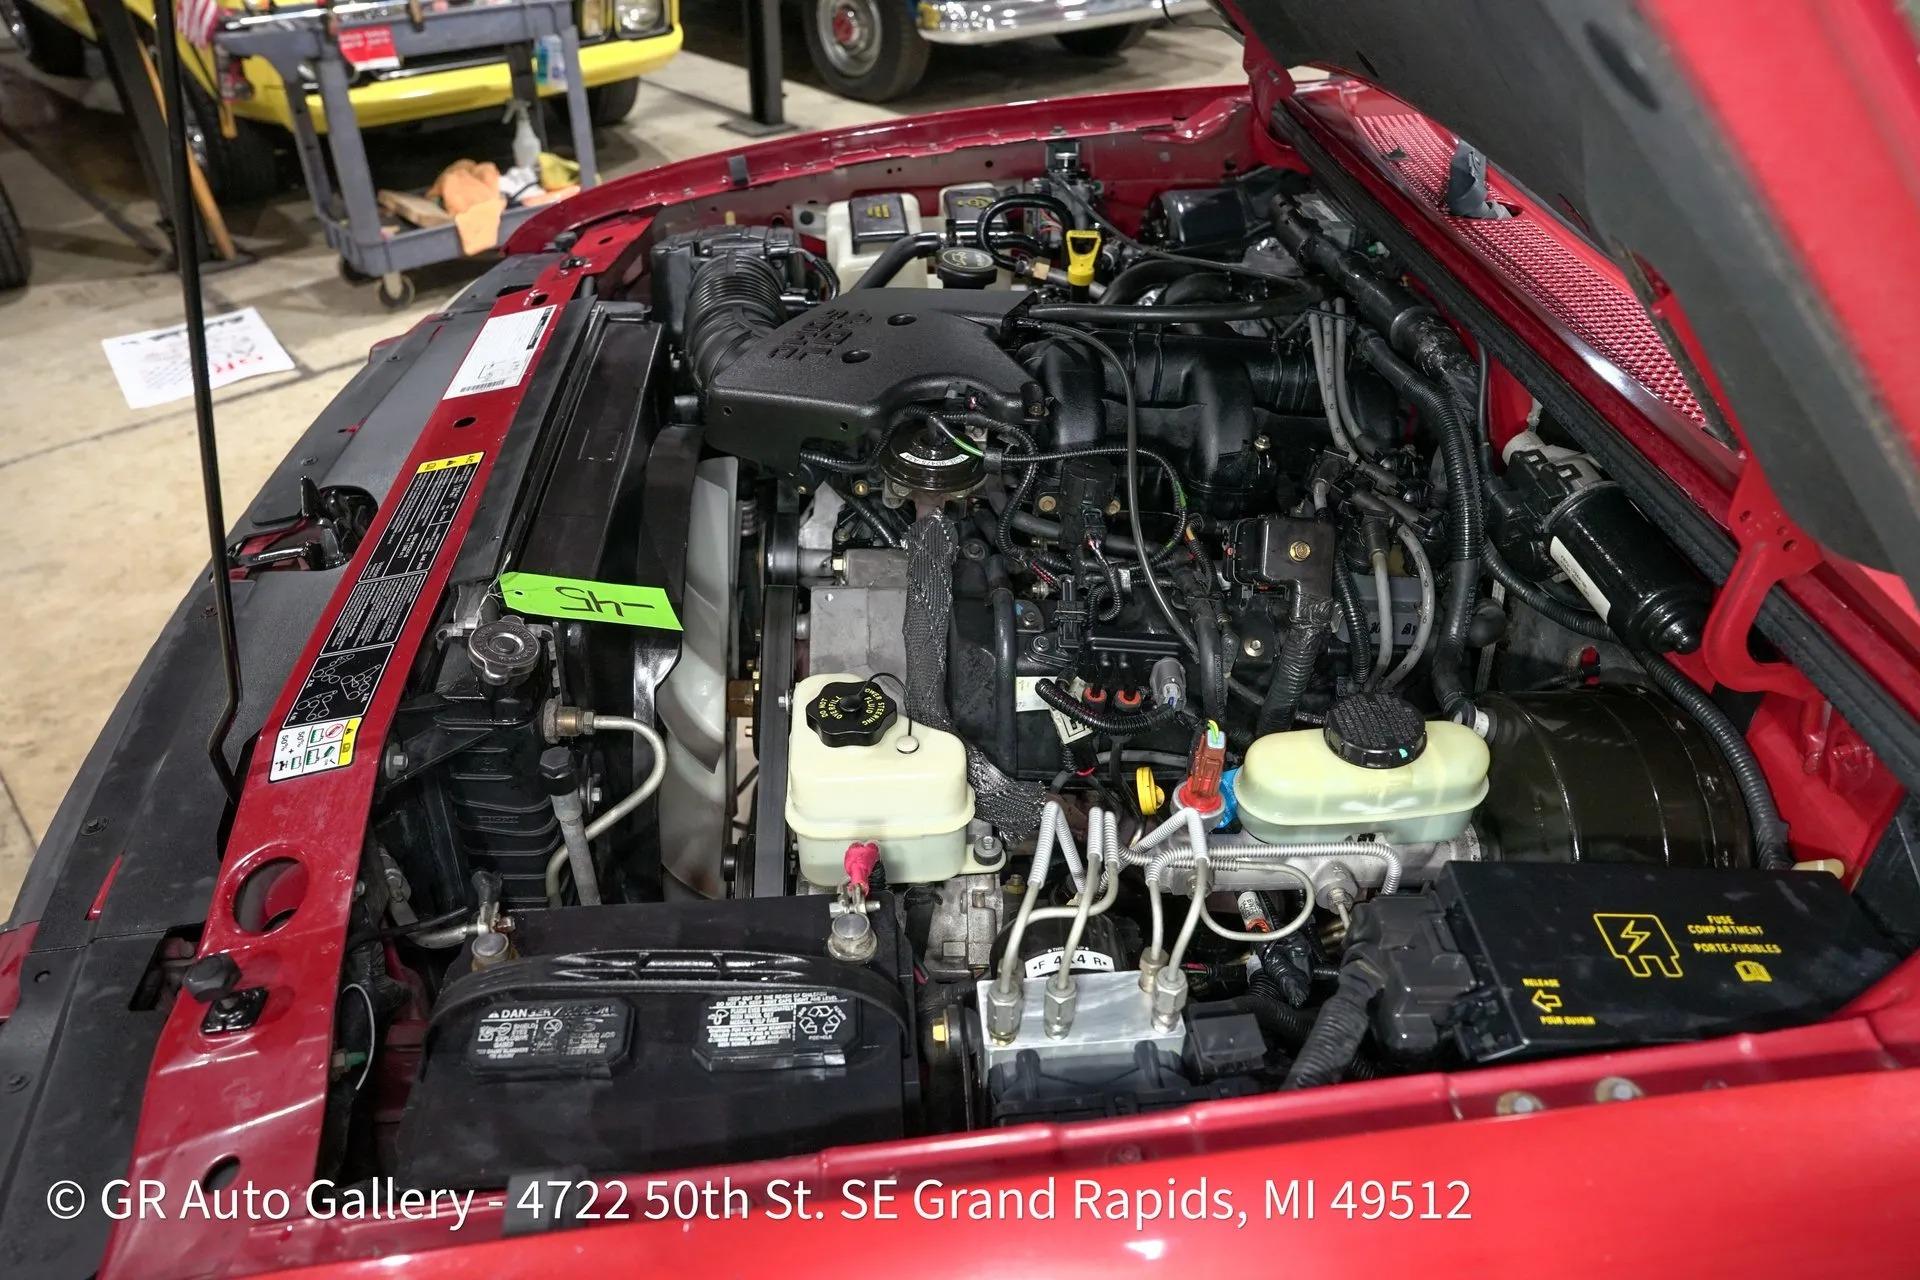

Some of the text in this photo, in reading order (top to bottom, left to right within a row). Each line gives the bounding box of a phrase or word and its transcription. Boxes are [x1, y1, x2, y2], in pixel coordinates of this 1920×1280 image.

[818, 698, 829, 718] DO NOT
[861, 687, 886, 726] OWER STEERING
[863, 696, 876, 714] FLUID
[1706, 914, 1735, 925] FUSE
[1687, 924, 1765, 937] COMPARTMENT
[1692, 943, 1783, 955] PORTE-FUSIBLES
[1053, 954, 1086, 965] 44
